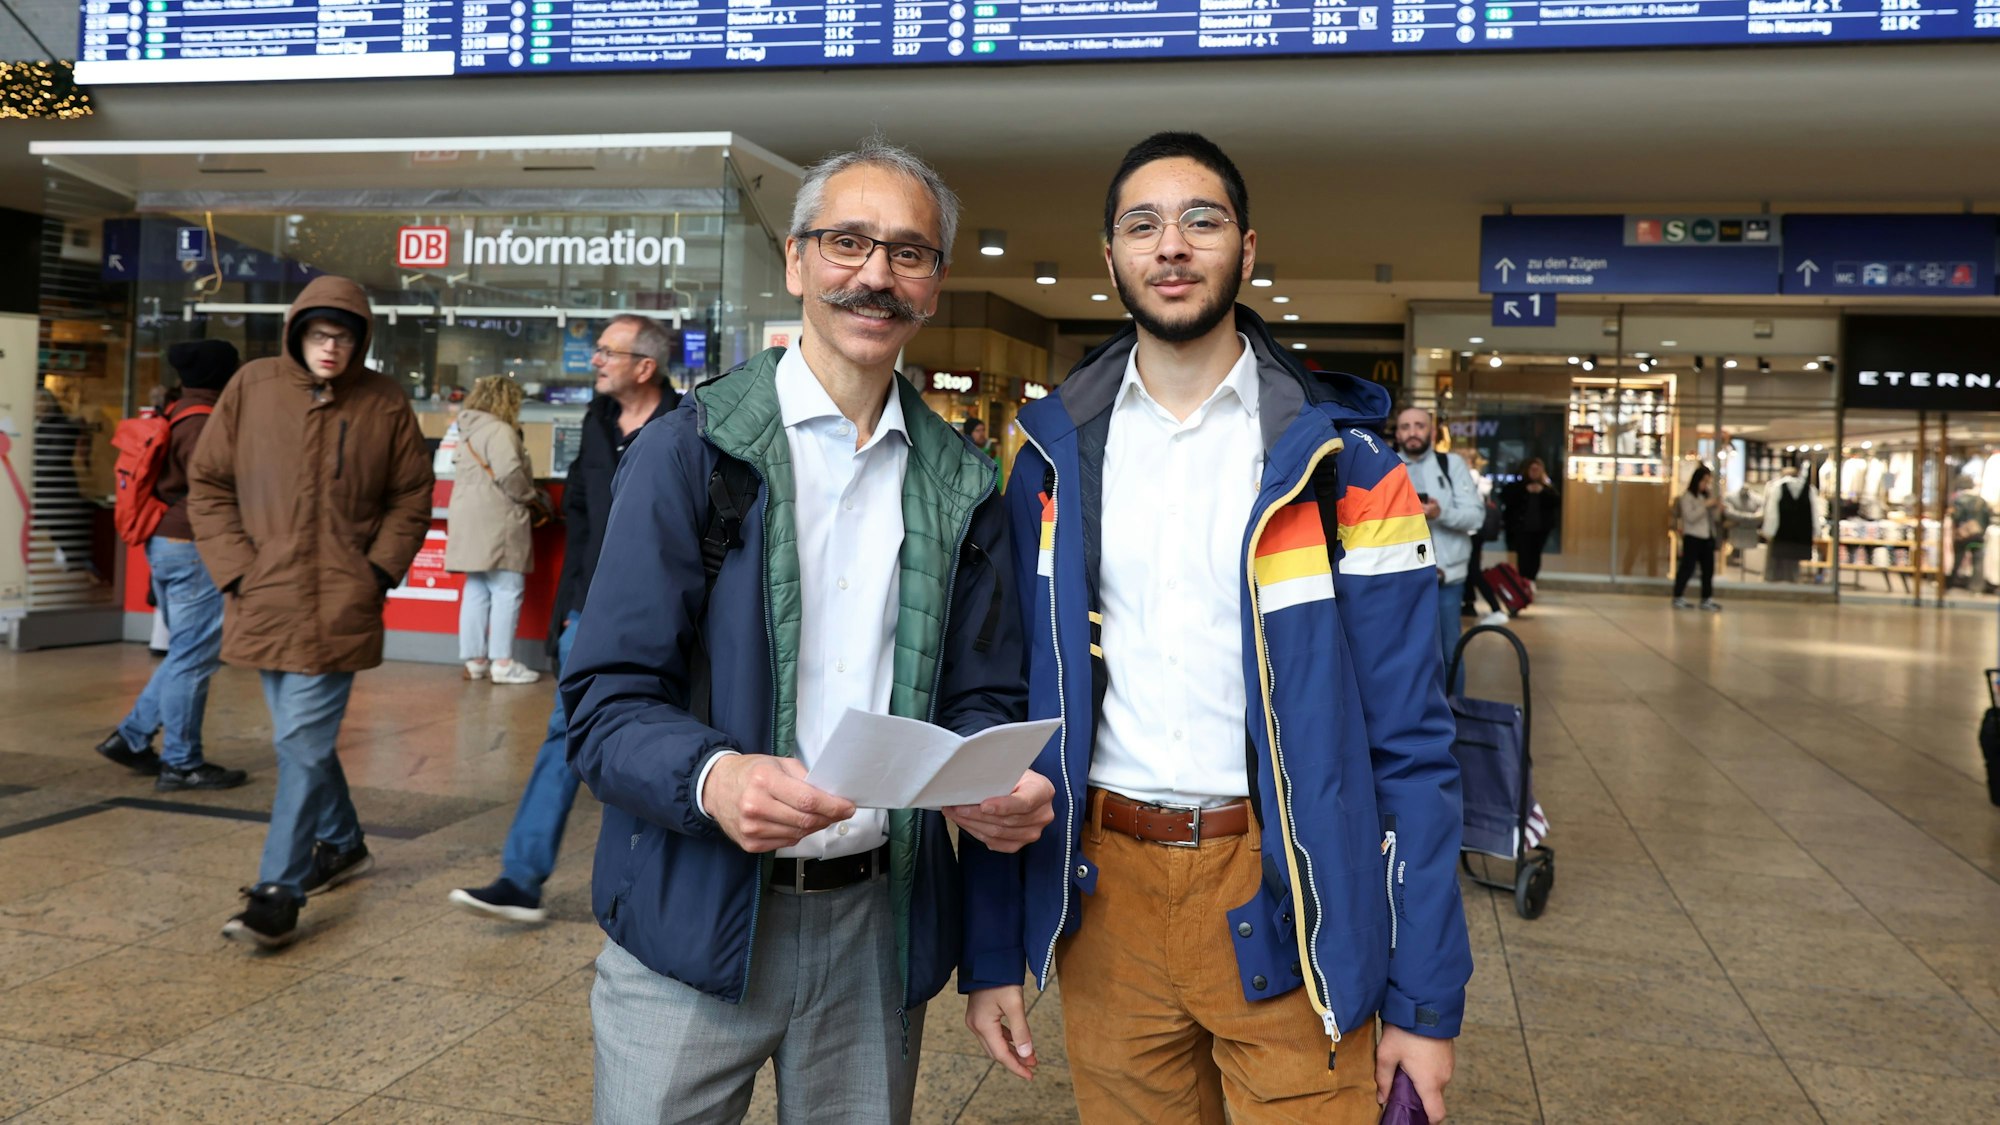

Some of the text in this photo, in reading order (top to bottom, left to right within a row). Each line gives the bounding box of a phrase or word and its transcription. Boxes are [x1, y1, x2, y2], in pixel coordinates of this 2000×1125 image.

[404, 234, 443, 259] DB
[463, 228, 686, 266] Information
[1528, 294, 1541, 317] 1
[932, 371, 973, 393] Stop
[1857, 370, 2000, 389] ETERN
